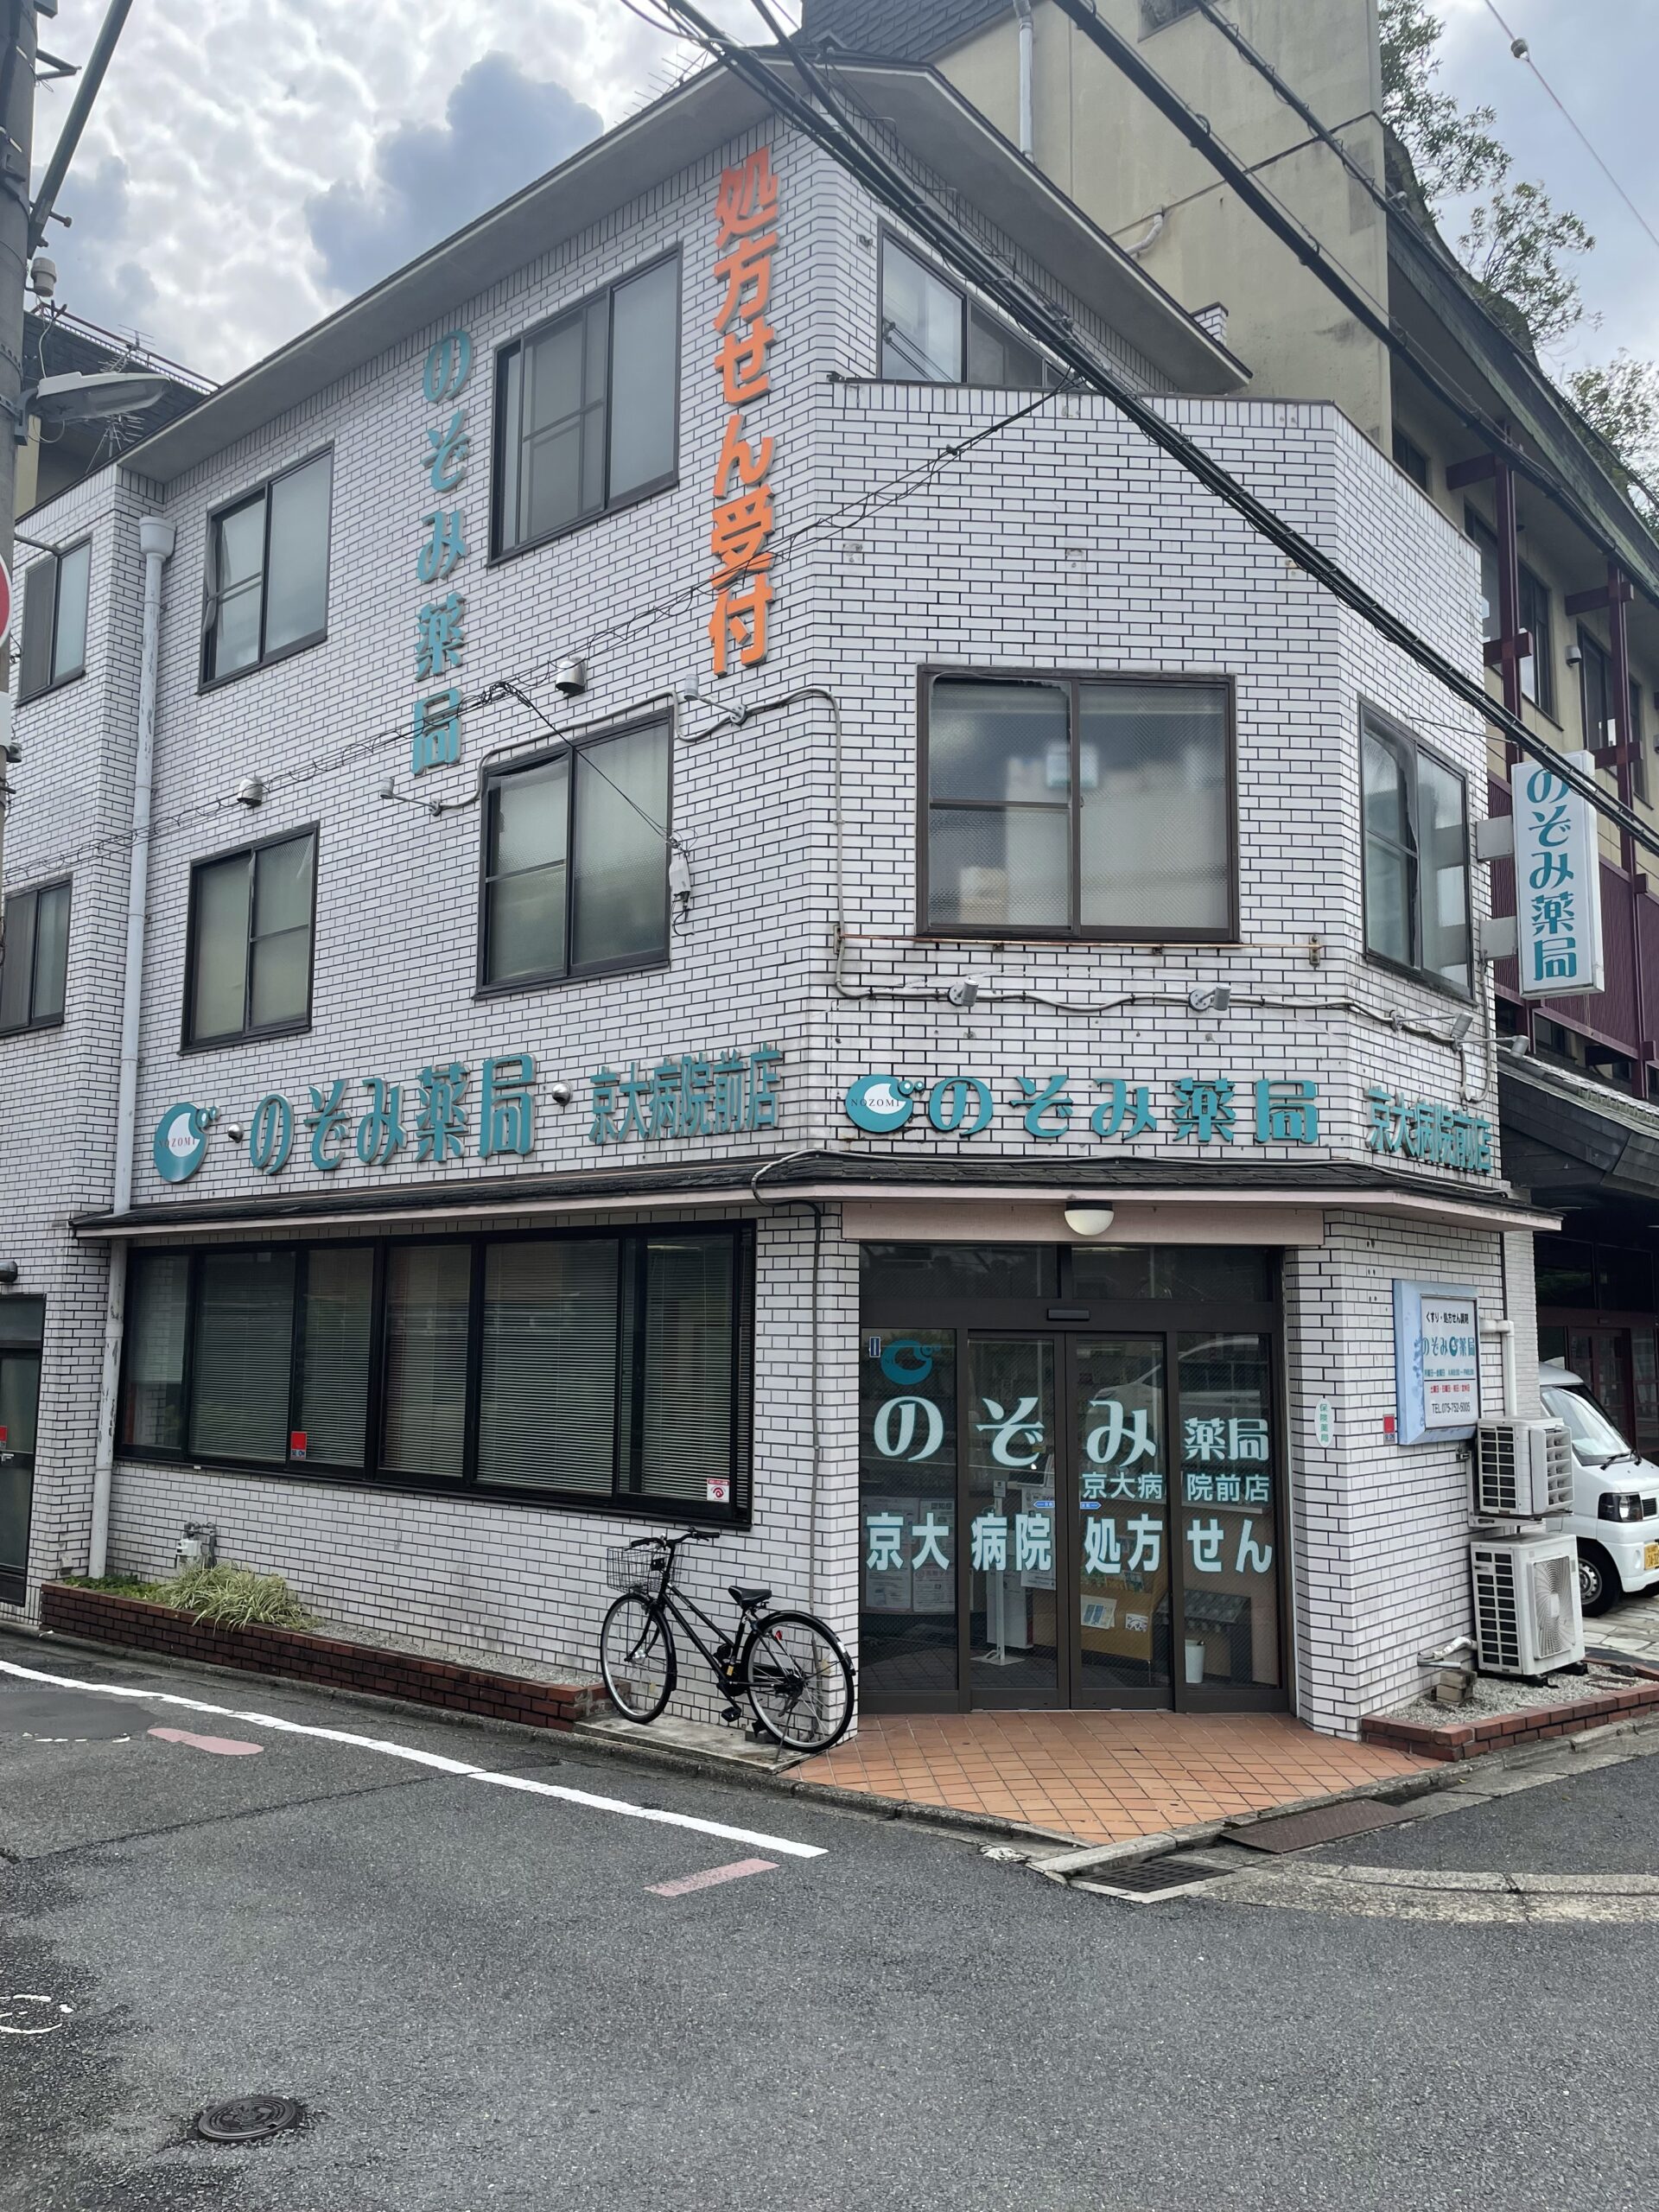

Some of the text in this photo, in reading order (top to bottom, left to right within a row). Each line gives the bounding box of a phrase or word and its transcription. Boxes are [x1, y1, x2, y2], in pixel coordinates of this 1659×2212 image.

[709, 146, 776, 677] 処方せん受付
[410, 327, 474, 777] のぞみ薬局
[1527, 768, 1576, 982] のぞみ薬局
[159, 1137, 196, 1148] NOZOMI
[251, 1042, 783, 1176] のぞみ薬局 京大病院前店
[850, 1098, 899, 1107] NOZOMI
[929, 1073, 1319, 1145] のぞみ薬局
[1365, 1085, 1492, 1173] 京大病院前店
